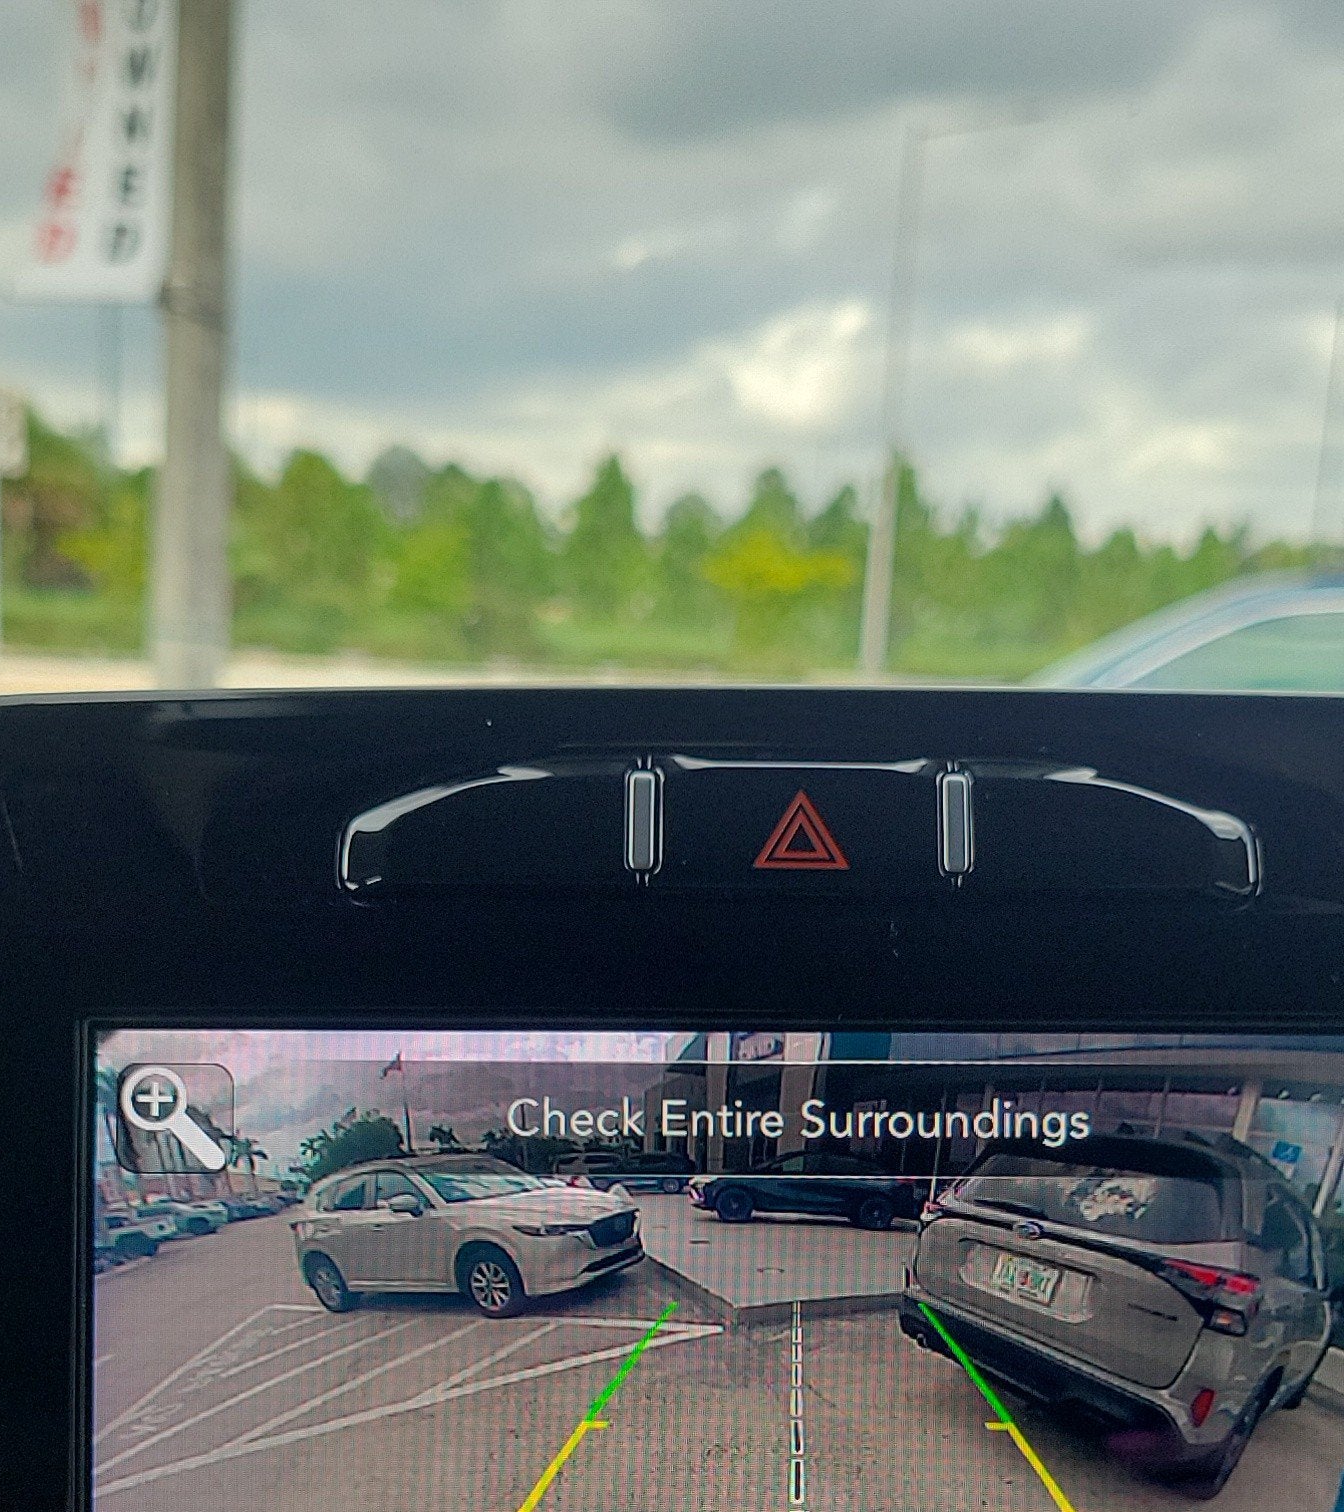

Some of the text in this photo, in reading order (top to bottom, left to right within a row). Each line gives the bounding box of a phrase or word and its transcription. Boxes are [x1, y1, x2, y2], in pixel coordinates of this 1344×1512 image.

[506, 1097, 1092, 1148] Check Entire Surroundings
